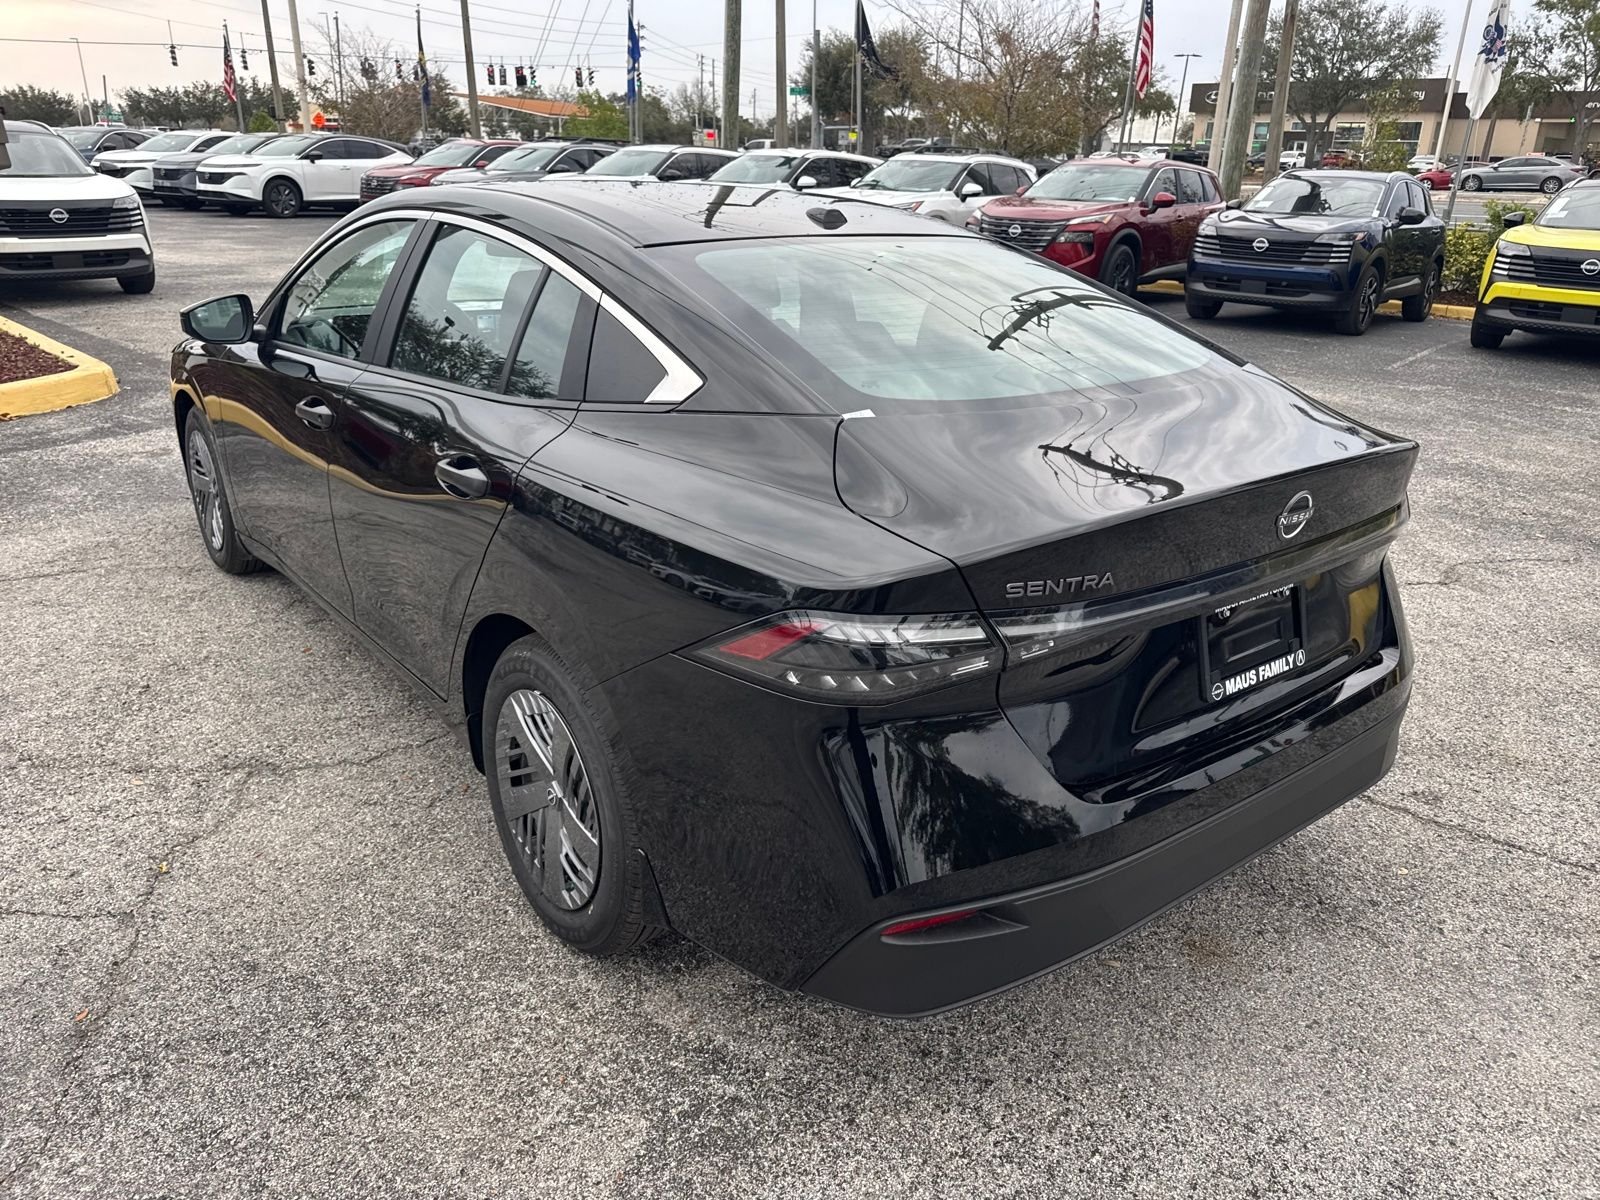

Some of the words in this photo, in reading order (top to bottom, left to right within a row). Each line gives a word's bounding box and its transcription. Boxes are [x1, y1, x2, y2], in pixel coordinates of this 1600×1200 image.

[1005, 572, 1115, 598] SENTRA
[1225, 669, 1257, 696] MAUS
[1259, 653, 1295, 682] FAMILY
